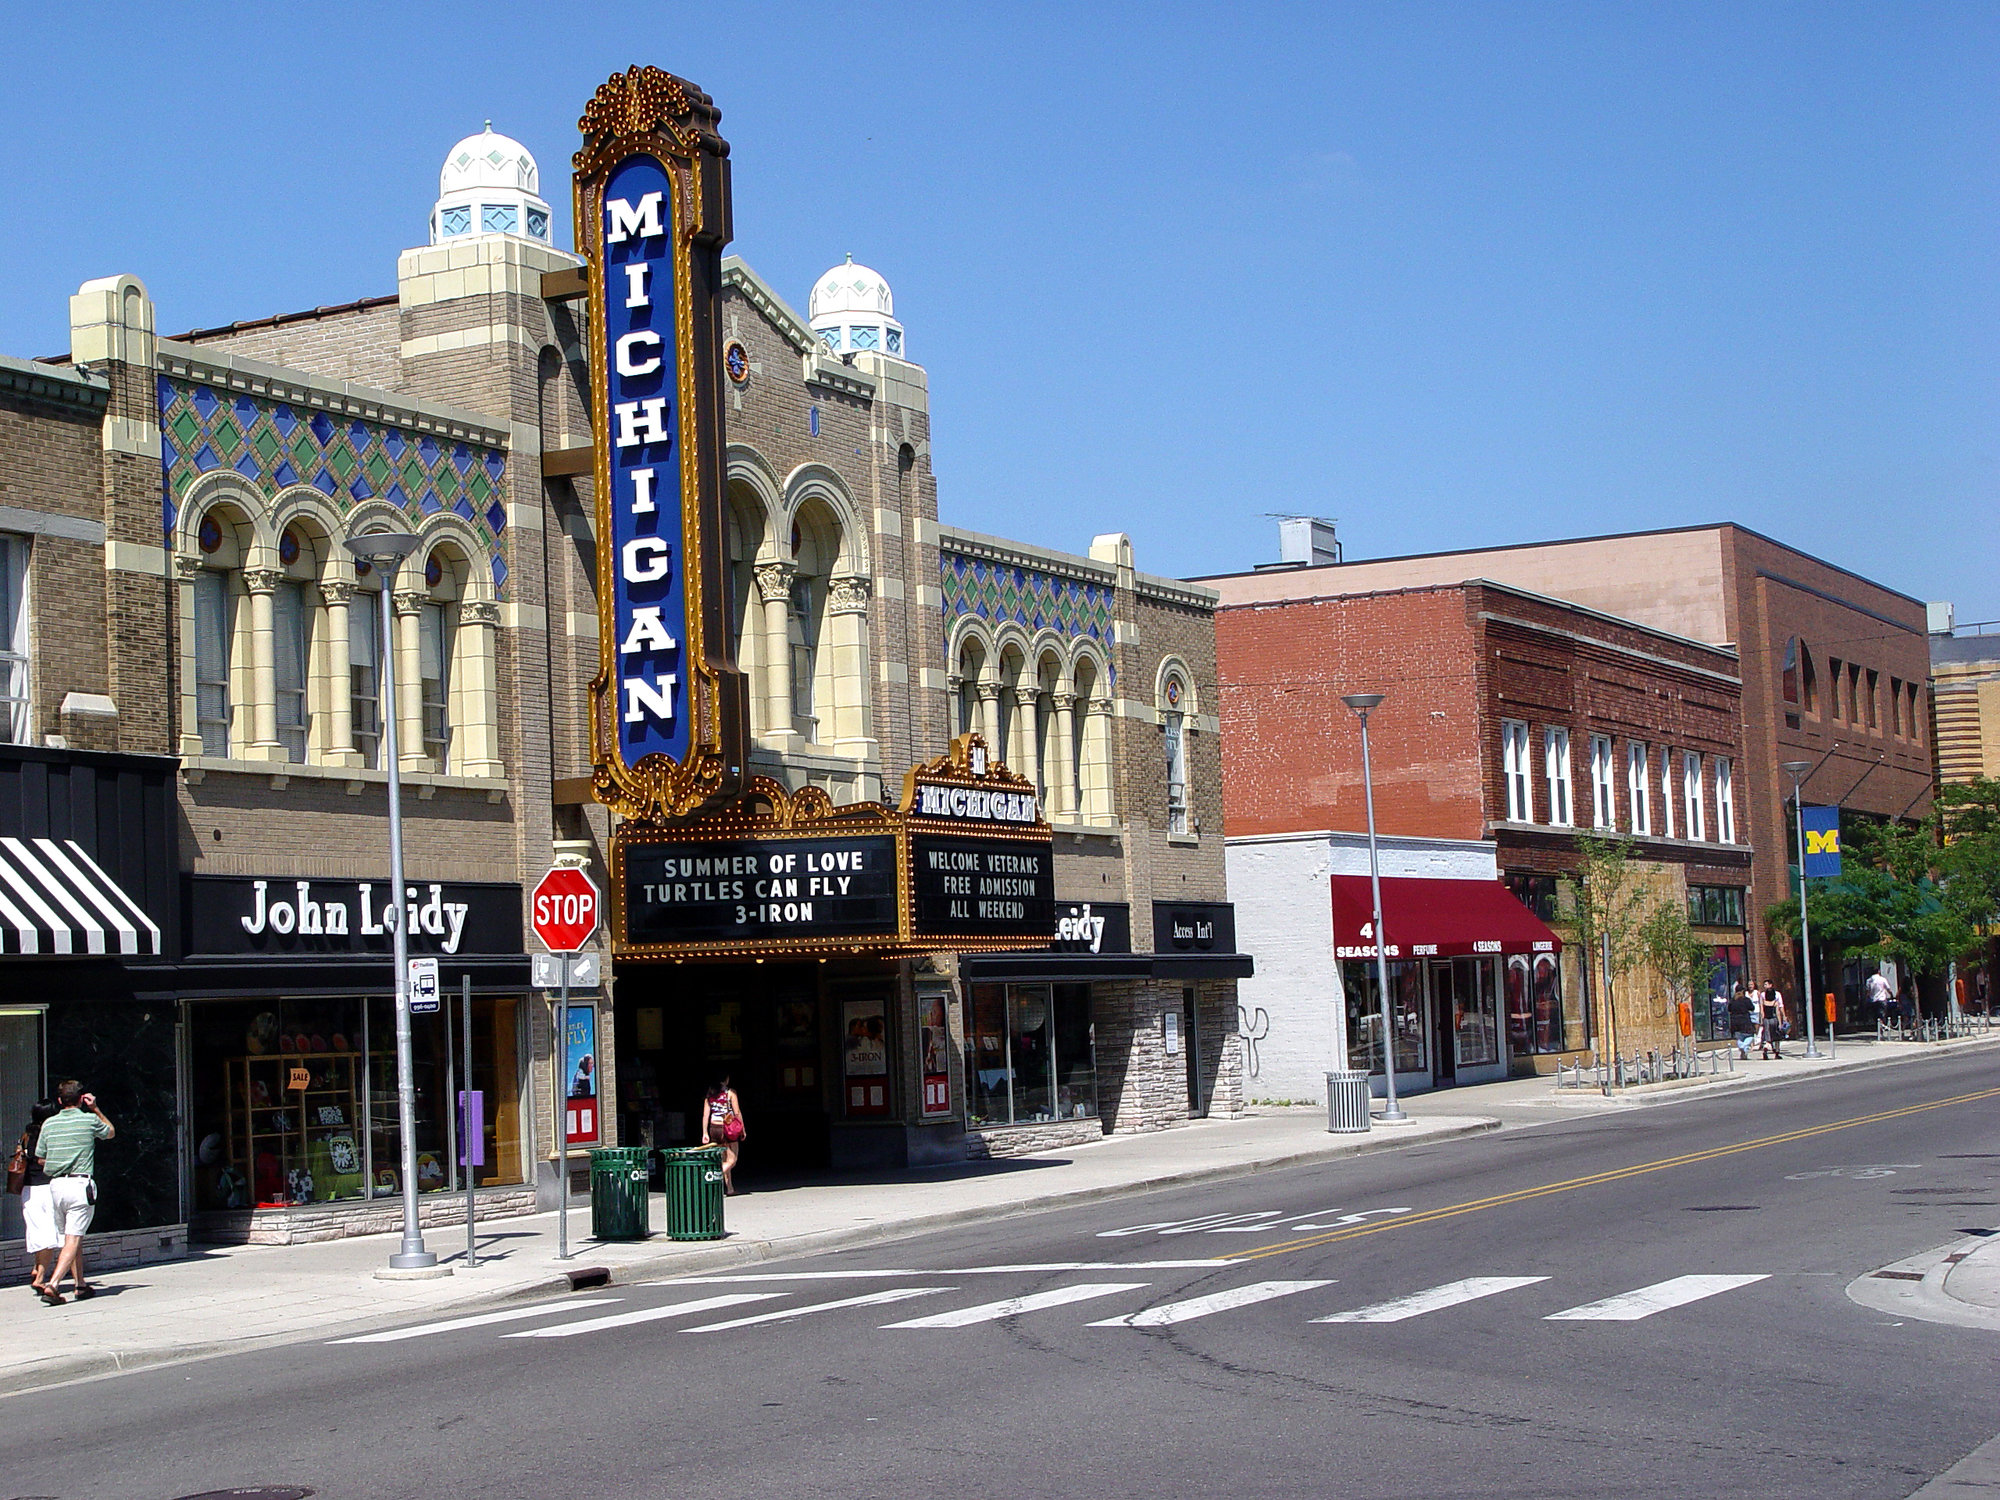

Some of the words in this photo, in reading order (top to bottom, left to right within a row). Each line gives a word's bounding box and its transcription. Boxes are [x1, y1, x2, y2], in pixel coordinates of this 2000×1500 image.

[606, 190, 676, 723] MICHIGAN
[921, 785, 1036, 823] MICHIGAN
[1806, 829, 1840, 854] M
[664, 856, 757, 878] SUMMER
[769, 854, 796, 873] OF
[807, 852, 863, 872] LOVE
[929, 851, 980, 871] WELCOME
[987, 855, 1039, 874] VETERANS
[644, 881, 744, 903] TURTLES
[755, 878, 798, 898] CAN
[810, 876, 851, 896] FLY
[944, 876, 971, 894] FREE
[980, 877, 1036, 896] ADMISSION
[241, 881, 348, 935] John
[536, 894, 593, 926] STOP
[736, 902, 813, 923] 3-IRON
[950, 901, 970, 918] ALL
[979, 901, 1024, 919] WEEKEND
[1055, 904, 1105, 954] eidy
[1173, 920, 1194, 939] Access
[1196, 921, 1213, 939] Int'l
[1360, 923, 1373, 938] 4
[851, 1051, 882, 1062] 3-IRON
[293, 1073, 308, 1081] SALE
[1096, 1206, 1412, 1237] STOP
